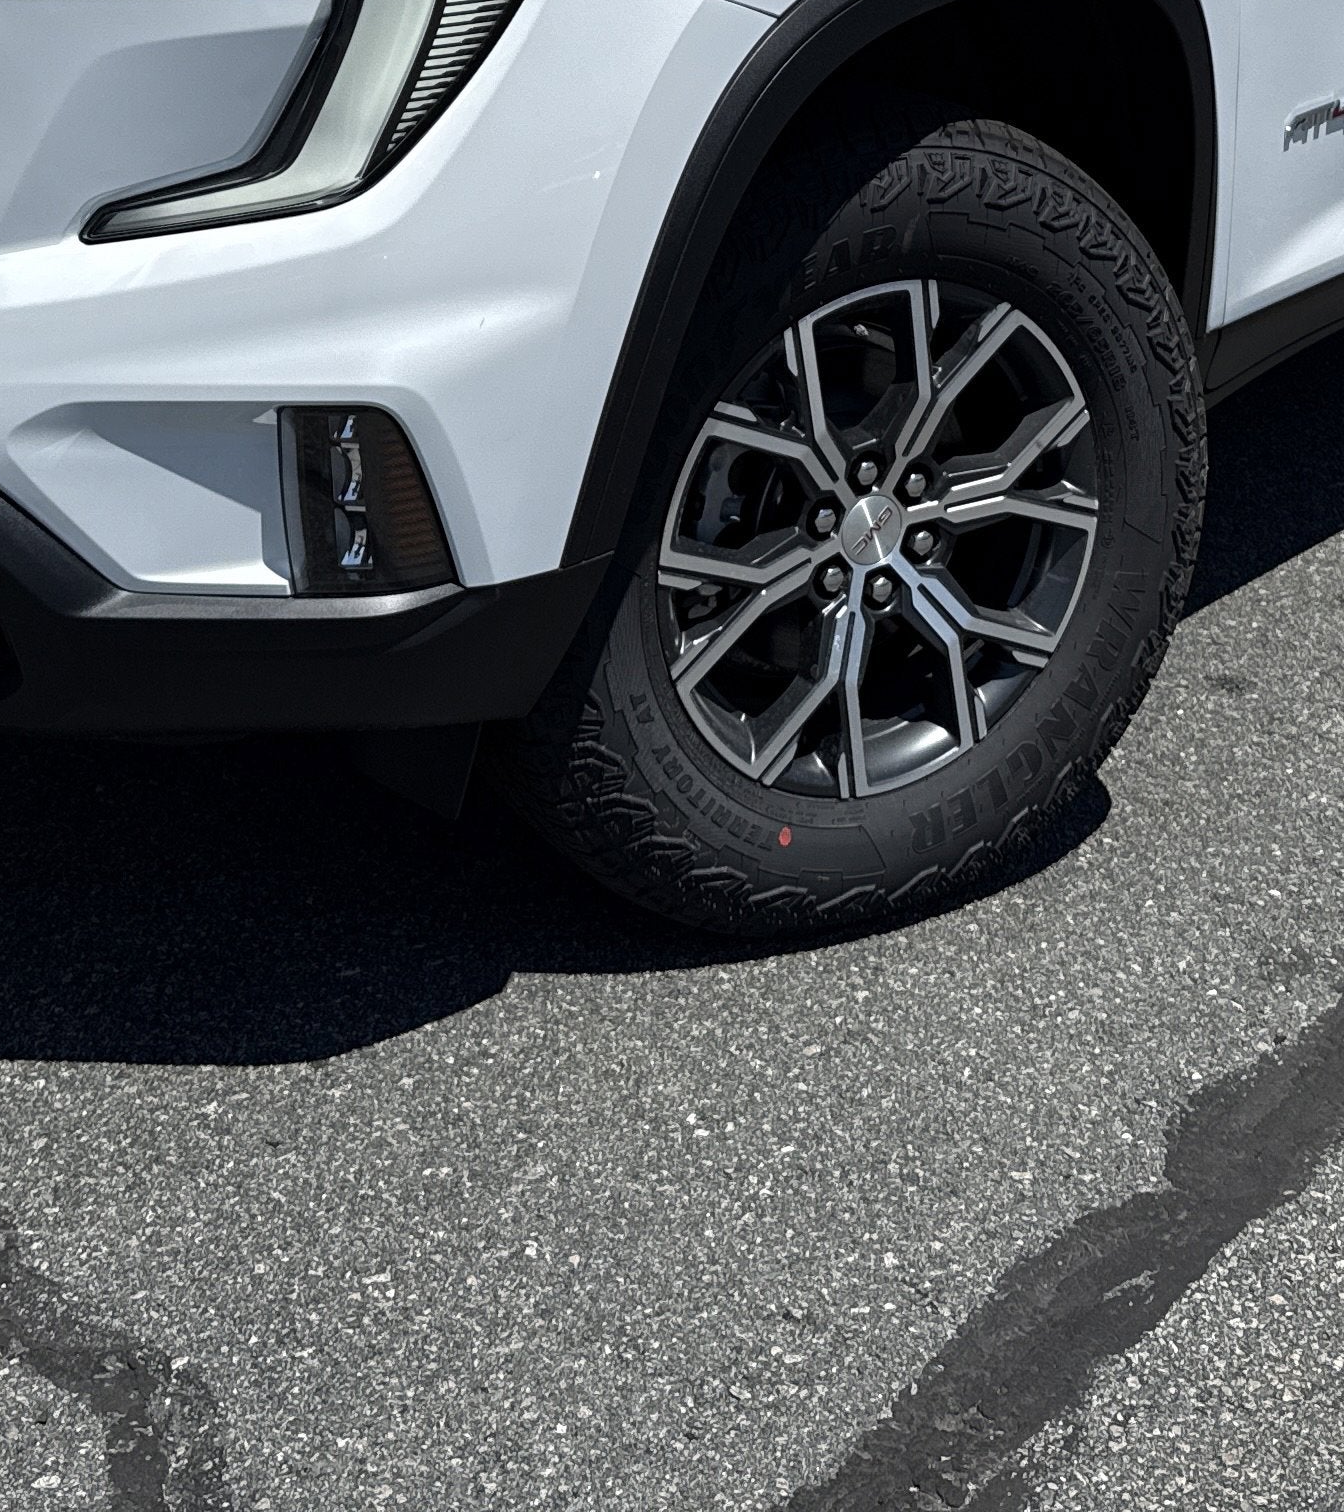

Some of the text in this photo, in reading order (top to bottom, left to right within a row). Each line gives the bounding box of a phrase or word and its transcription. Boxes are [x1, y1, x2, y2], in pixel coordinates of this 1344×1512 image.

[850, 505, 894, 556] GMC
[630, 694, 655, 723] AT
[908, 571, 1148, 854] WRANGLER
[652, 745, 777, 851] TERRITORY
